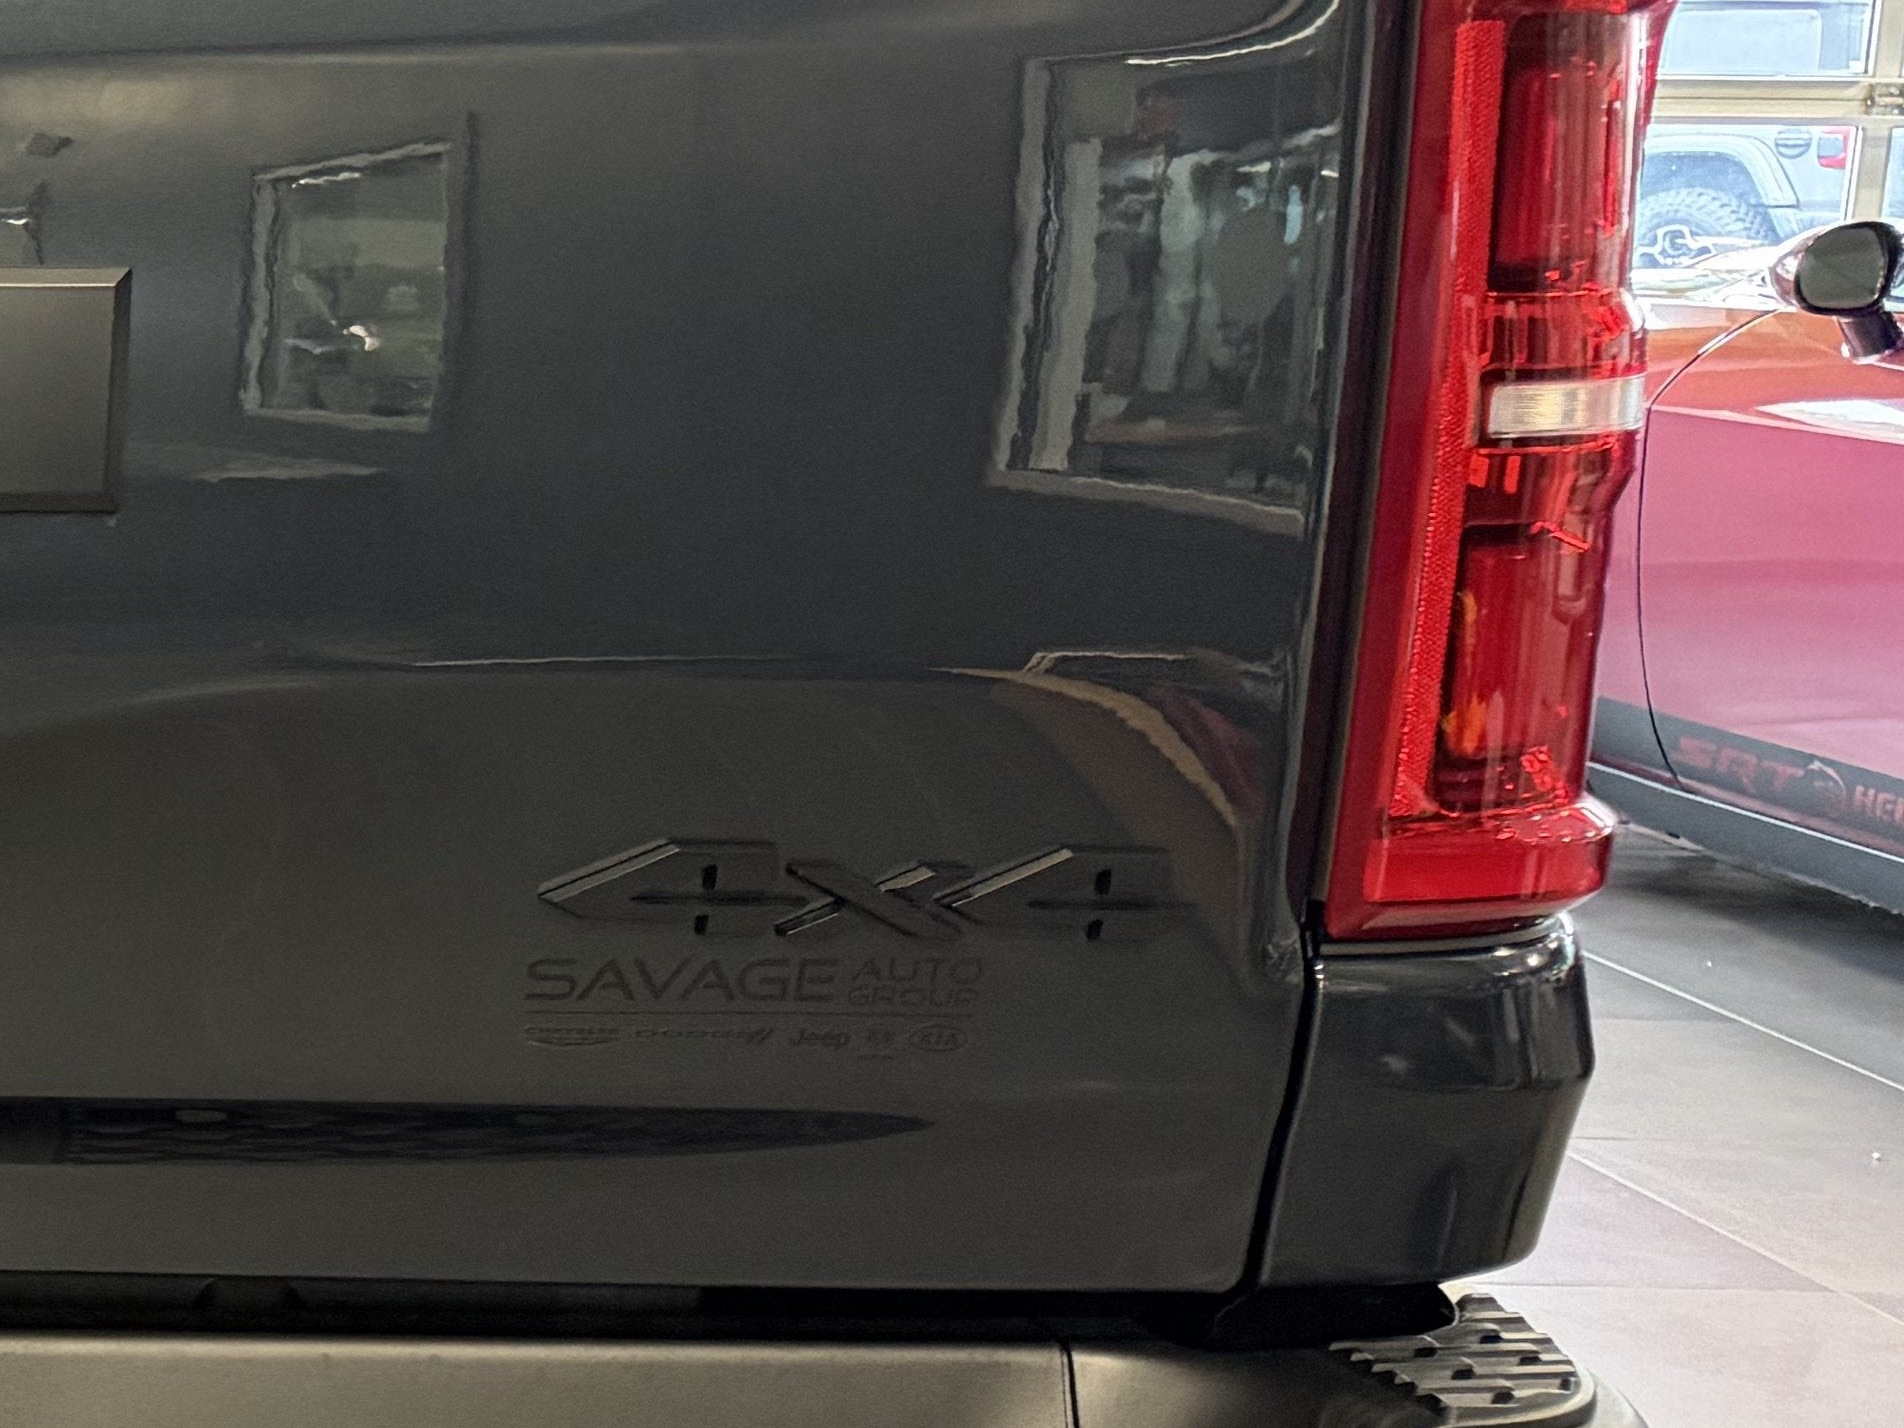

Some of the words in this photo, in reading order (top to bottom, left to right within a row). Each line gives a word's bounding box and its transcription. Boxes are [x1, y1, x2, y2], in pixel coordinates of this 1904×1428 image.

[523, 957, 840, 1002] SAVAGE
[851, 956, 983, 985] AUTO
[847, 984, 981, 1007] GROUP
